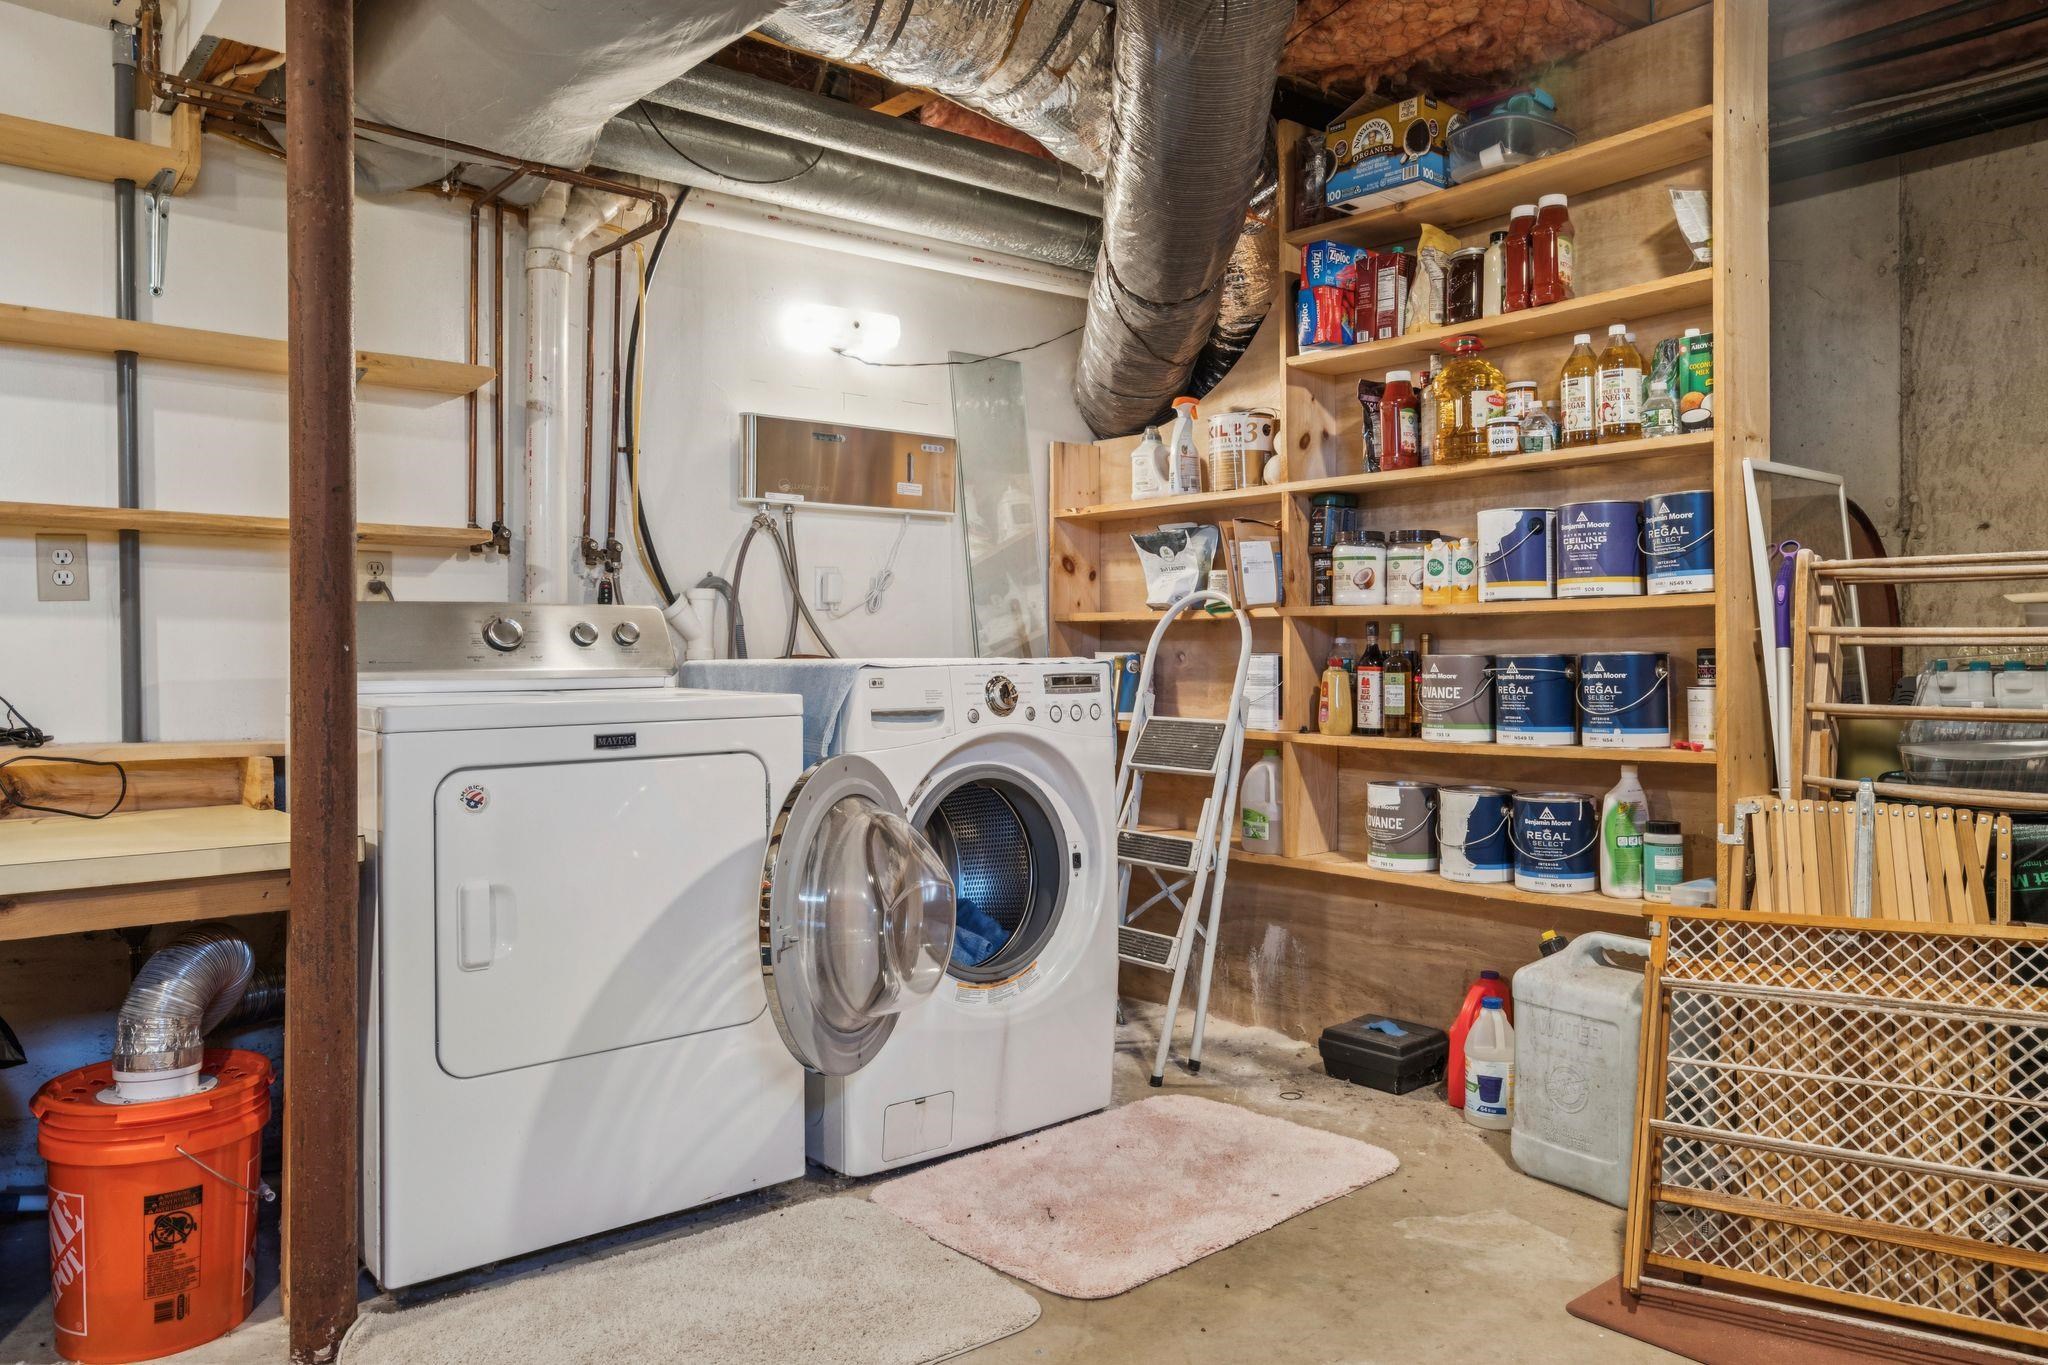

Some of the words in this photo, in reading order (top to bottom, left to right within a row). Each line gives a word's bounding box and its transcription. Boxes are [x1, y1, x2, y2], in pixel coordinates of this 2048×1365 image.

[1352, 145, 1393, 162] ORGANICS
[1423, 167, 1434, 180] 100
[1326, 189, 1342, 203] 100
[1329, 249, 1350, 265] Ziploc
[1311, 251, 1322, 279] Ziploc
[1301, 303, 1311, 330] Ziploc
[1688, 360, 1713, 370] COCONU
[1669, 512, 1693, 520] Moore
[1561, 522, 1586, 531] Benjamin
[1648, 526, 1690, 539] REGAL
[1563, 536, 1607, 545] CEILING
[1566, 543, 1602, 551] PAINT
[1498, 686, 1533, 695] REGAL
[1584, 685, 1622, 694] REGAL
[598, 736, 635, 746] MAYTAG
[1524, 818, 1550, 826] Benjamin
[1526, 830, 1571, 841] REGAL
[1538, 1011, 1603, 1049] WATER
[159, 1194, 197, 1207] ADVERTENCIA
